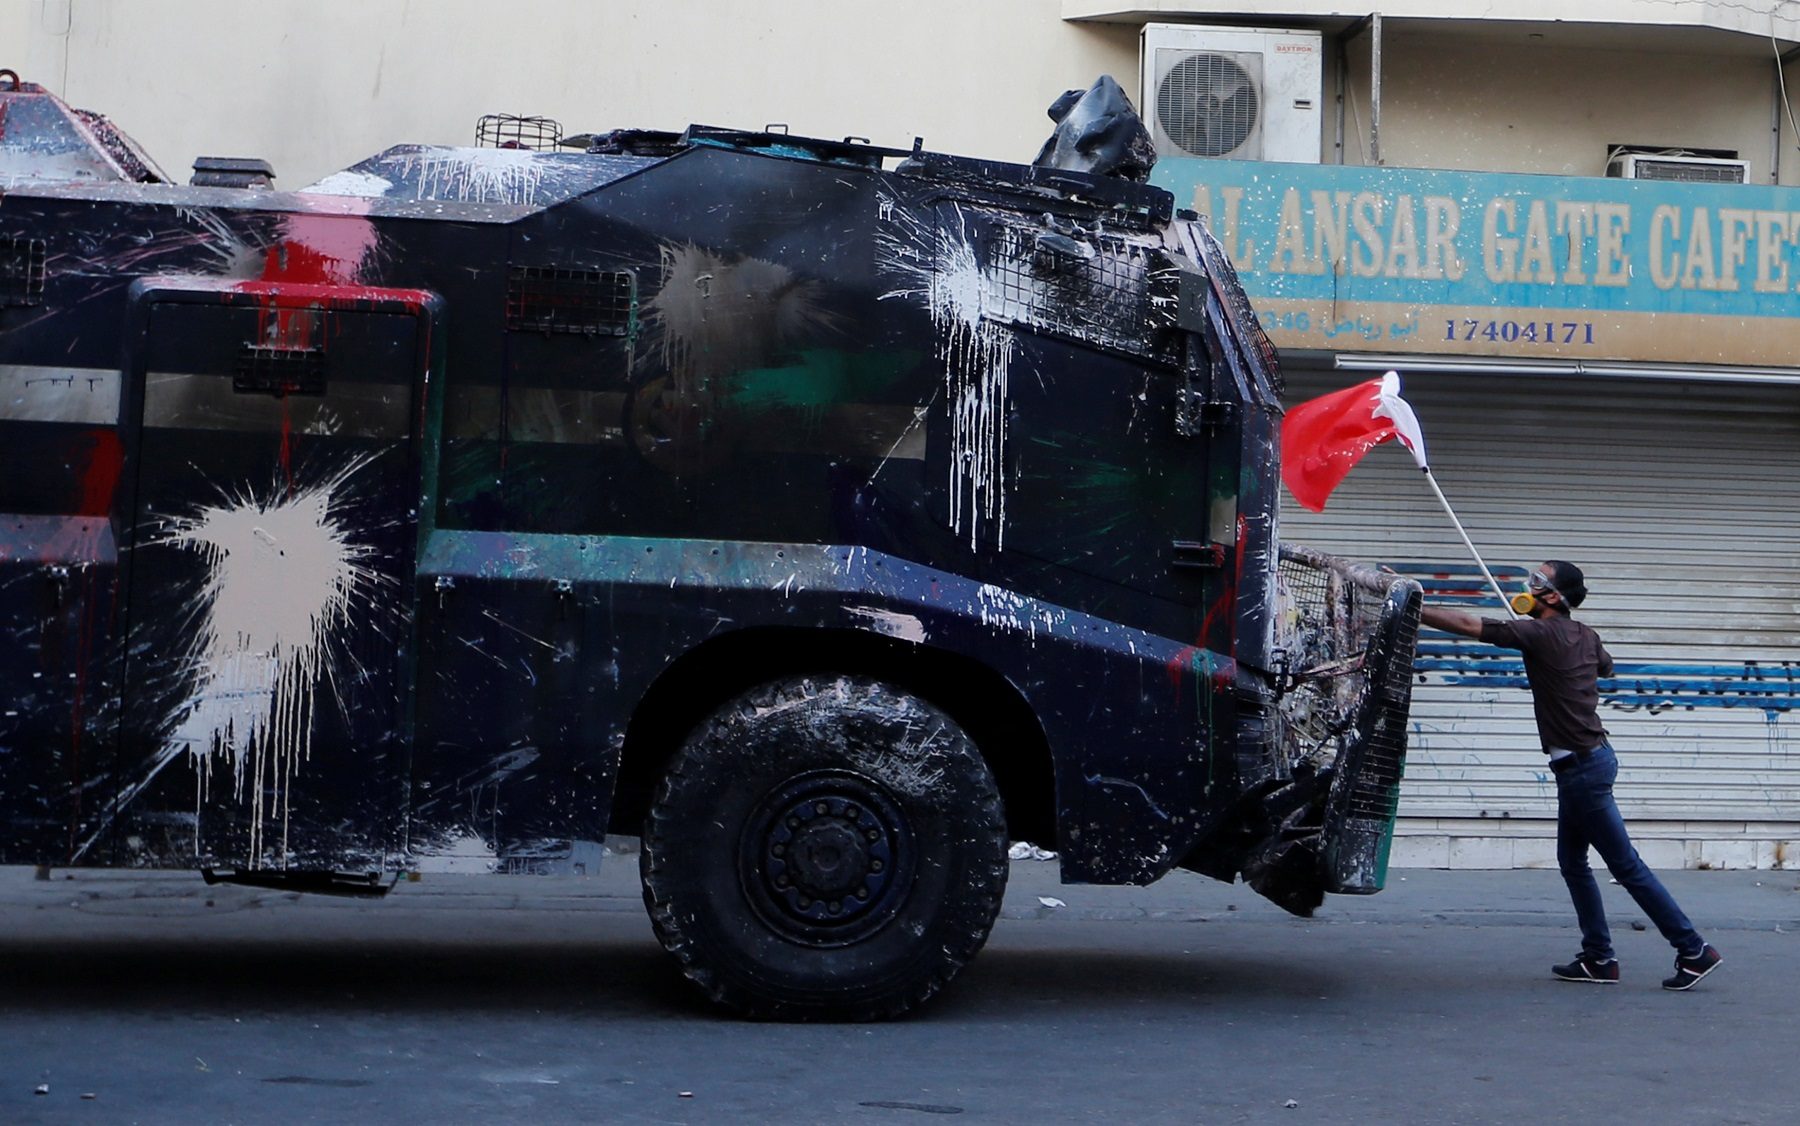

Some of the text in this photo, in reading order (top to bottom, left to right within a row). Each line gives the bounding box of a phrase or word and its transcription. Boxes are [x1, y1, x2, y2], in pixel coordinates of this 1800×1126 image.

[1268, 189, 1464, 281] ANSAR
[1483, 197, 1631, 286] GATE
[1649, 204, 1800, 293] CAFE
[1445, 319, 1595, 345] 17404171
